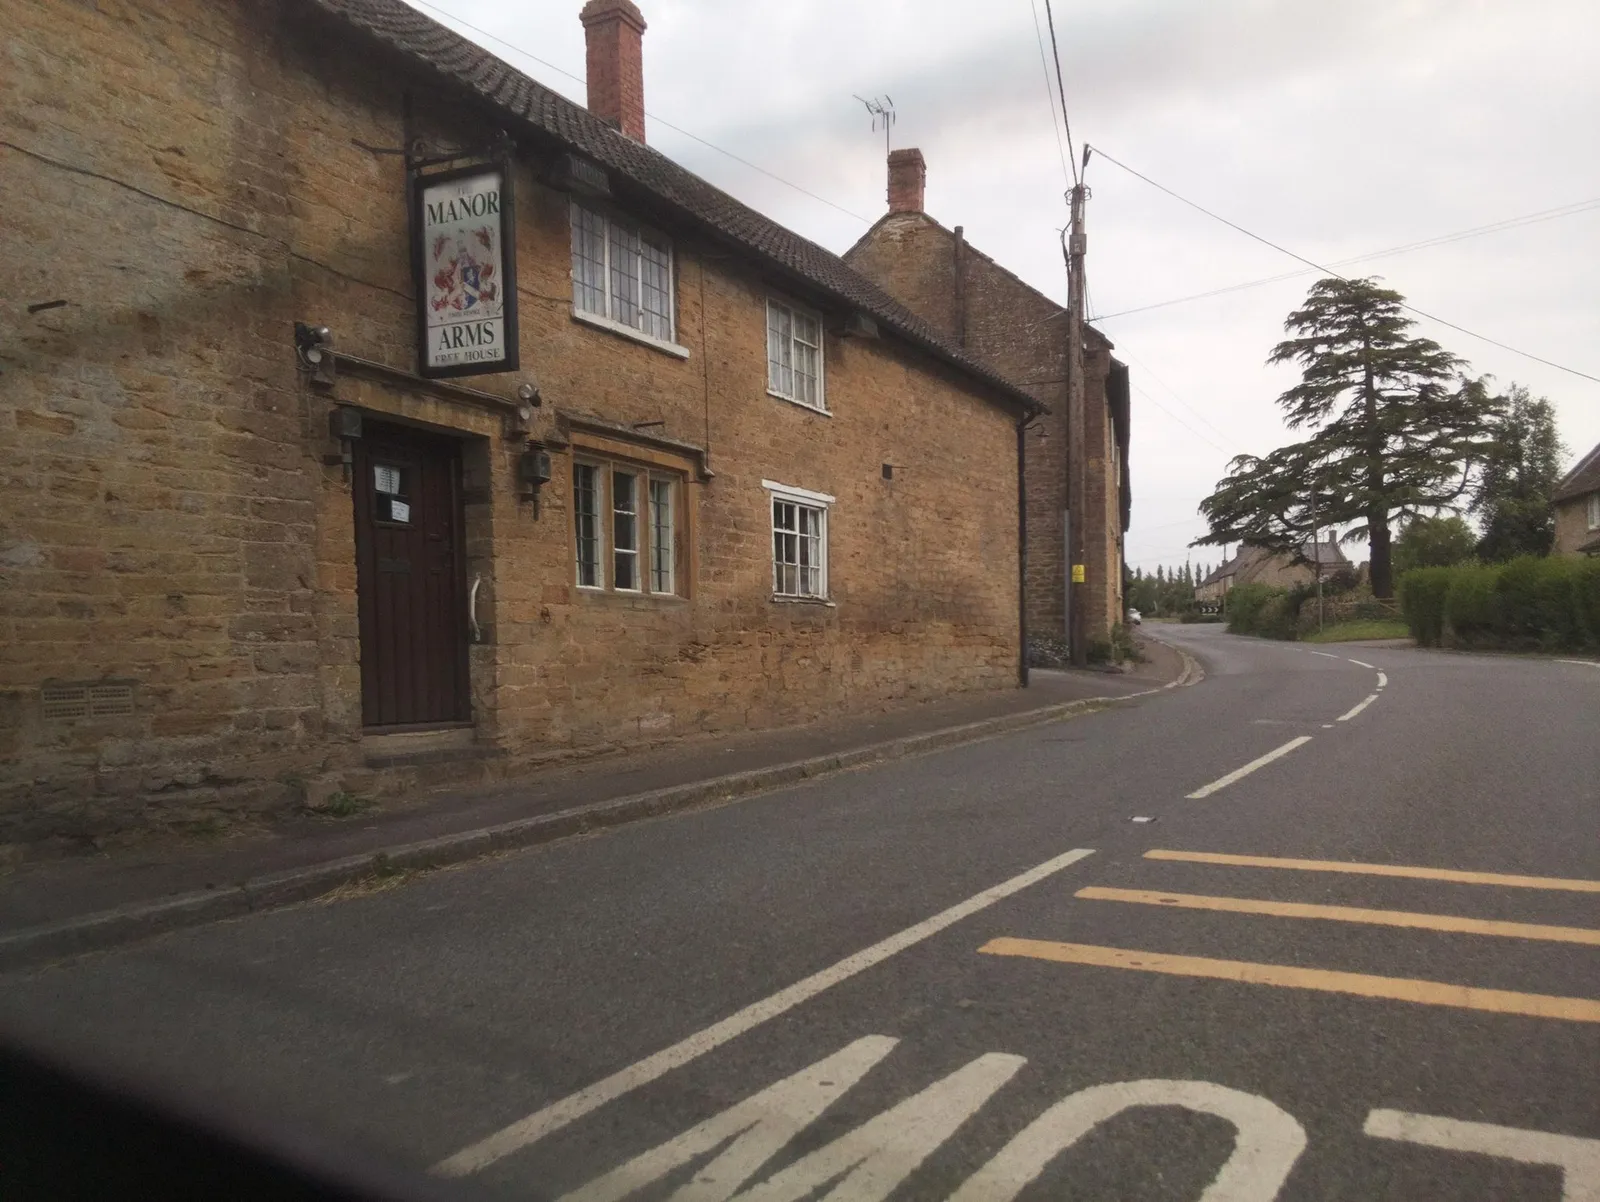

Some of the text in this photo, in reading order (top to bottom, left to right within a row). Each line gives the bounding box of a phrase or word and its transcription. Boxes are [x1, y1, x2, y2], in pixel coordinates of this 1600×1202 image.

[427, 191, 500, 226] MANOR
[438, 321, 495, 350] ARMS
[464, 348, 501, 361] HOUSE
